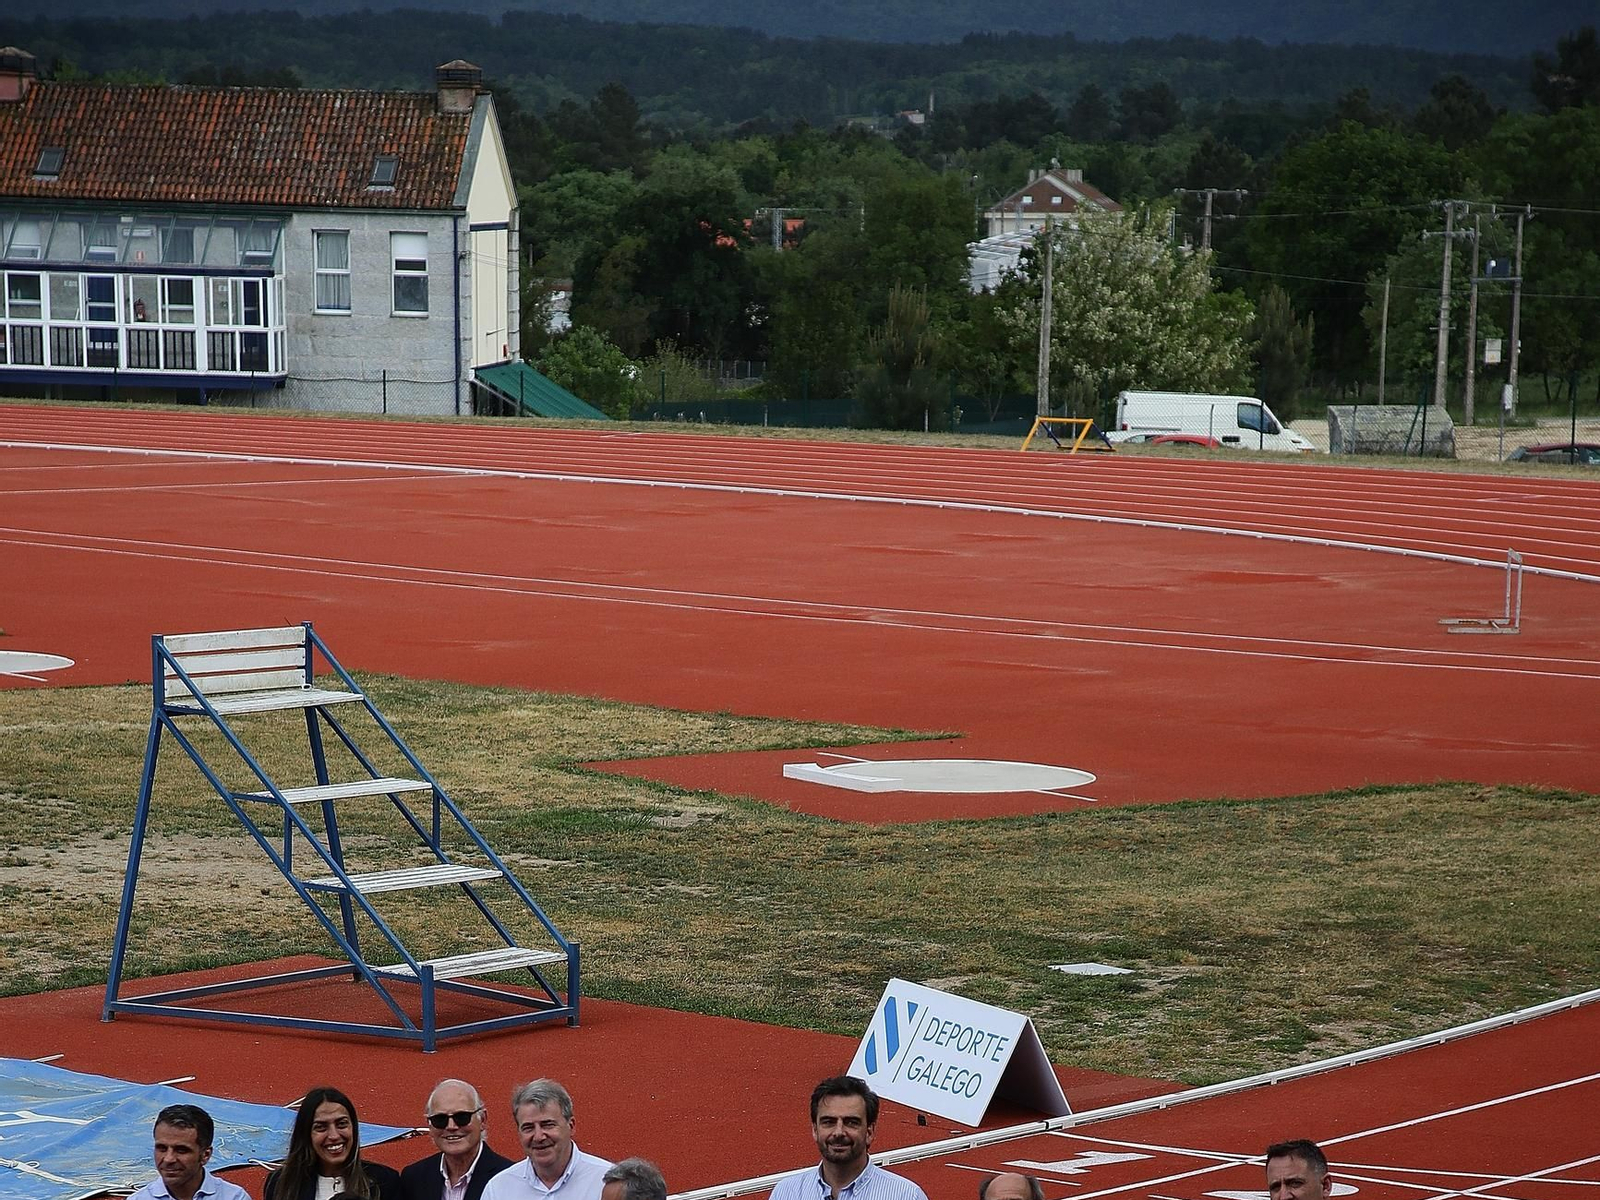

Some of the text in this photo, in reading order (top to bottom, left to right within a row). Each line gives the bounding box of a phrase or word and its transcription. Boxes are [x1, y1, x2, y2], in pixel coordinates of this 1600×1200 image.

[923, 1017, 1009, 1062] DEPORTE
[907, 1055, 982, 1098] GALEGO
[1000, 1150, 1156, 1174] 1
